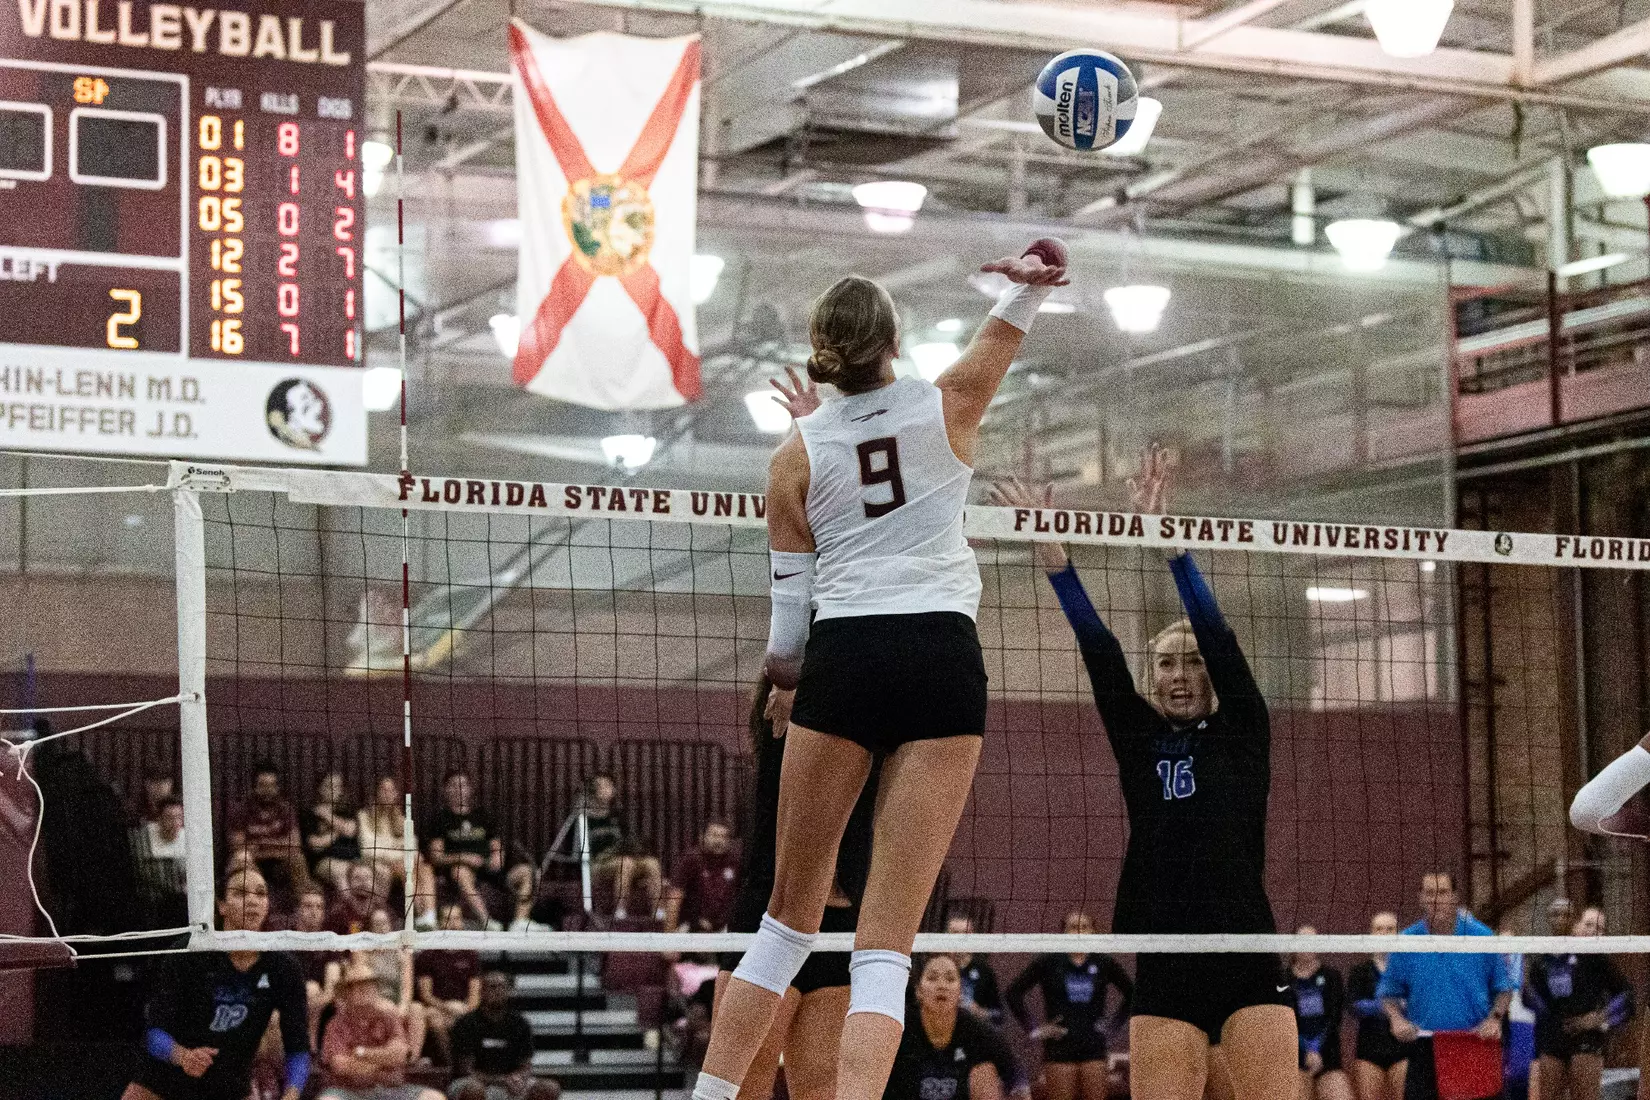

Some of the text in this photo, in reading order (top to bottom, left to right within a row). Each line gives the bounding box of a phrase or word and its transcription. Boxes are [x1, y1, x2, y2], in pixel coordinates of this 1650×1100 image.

[18, 0, 350, 66] VOLLEYBALL
[1056, 81, 1074, 137] molten
[199, 115, 355, 160] 01 8 1
[199, 155, 355, 199] 03 1 4
[199, 195, 355, 240] 05 0 2
[210, 237, 355, 279] 12 2 7
[107, 288, 142, 349] 2
[210, 278, 355, 320] 15 0 1
[210, 319, 355, 360] 16 7 1
[146, 375, 206, 404] M.D.
[146, 410, 199, 439] J.D.
[195, 468, 226, 477] Senoh
[856, 436, 907, 518] 9
[397, 477, 548, 508] FLORIDA
[564, 486, 671, 514] STATE
[1013, 509, 1145, 538] FLORIDA
[1159, 516, 1254, 543] STATE
[1272, 522, 1450, 553] UNIVERSITY
[1156, 755, 1196, 801] 16
